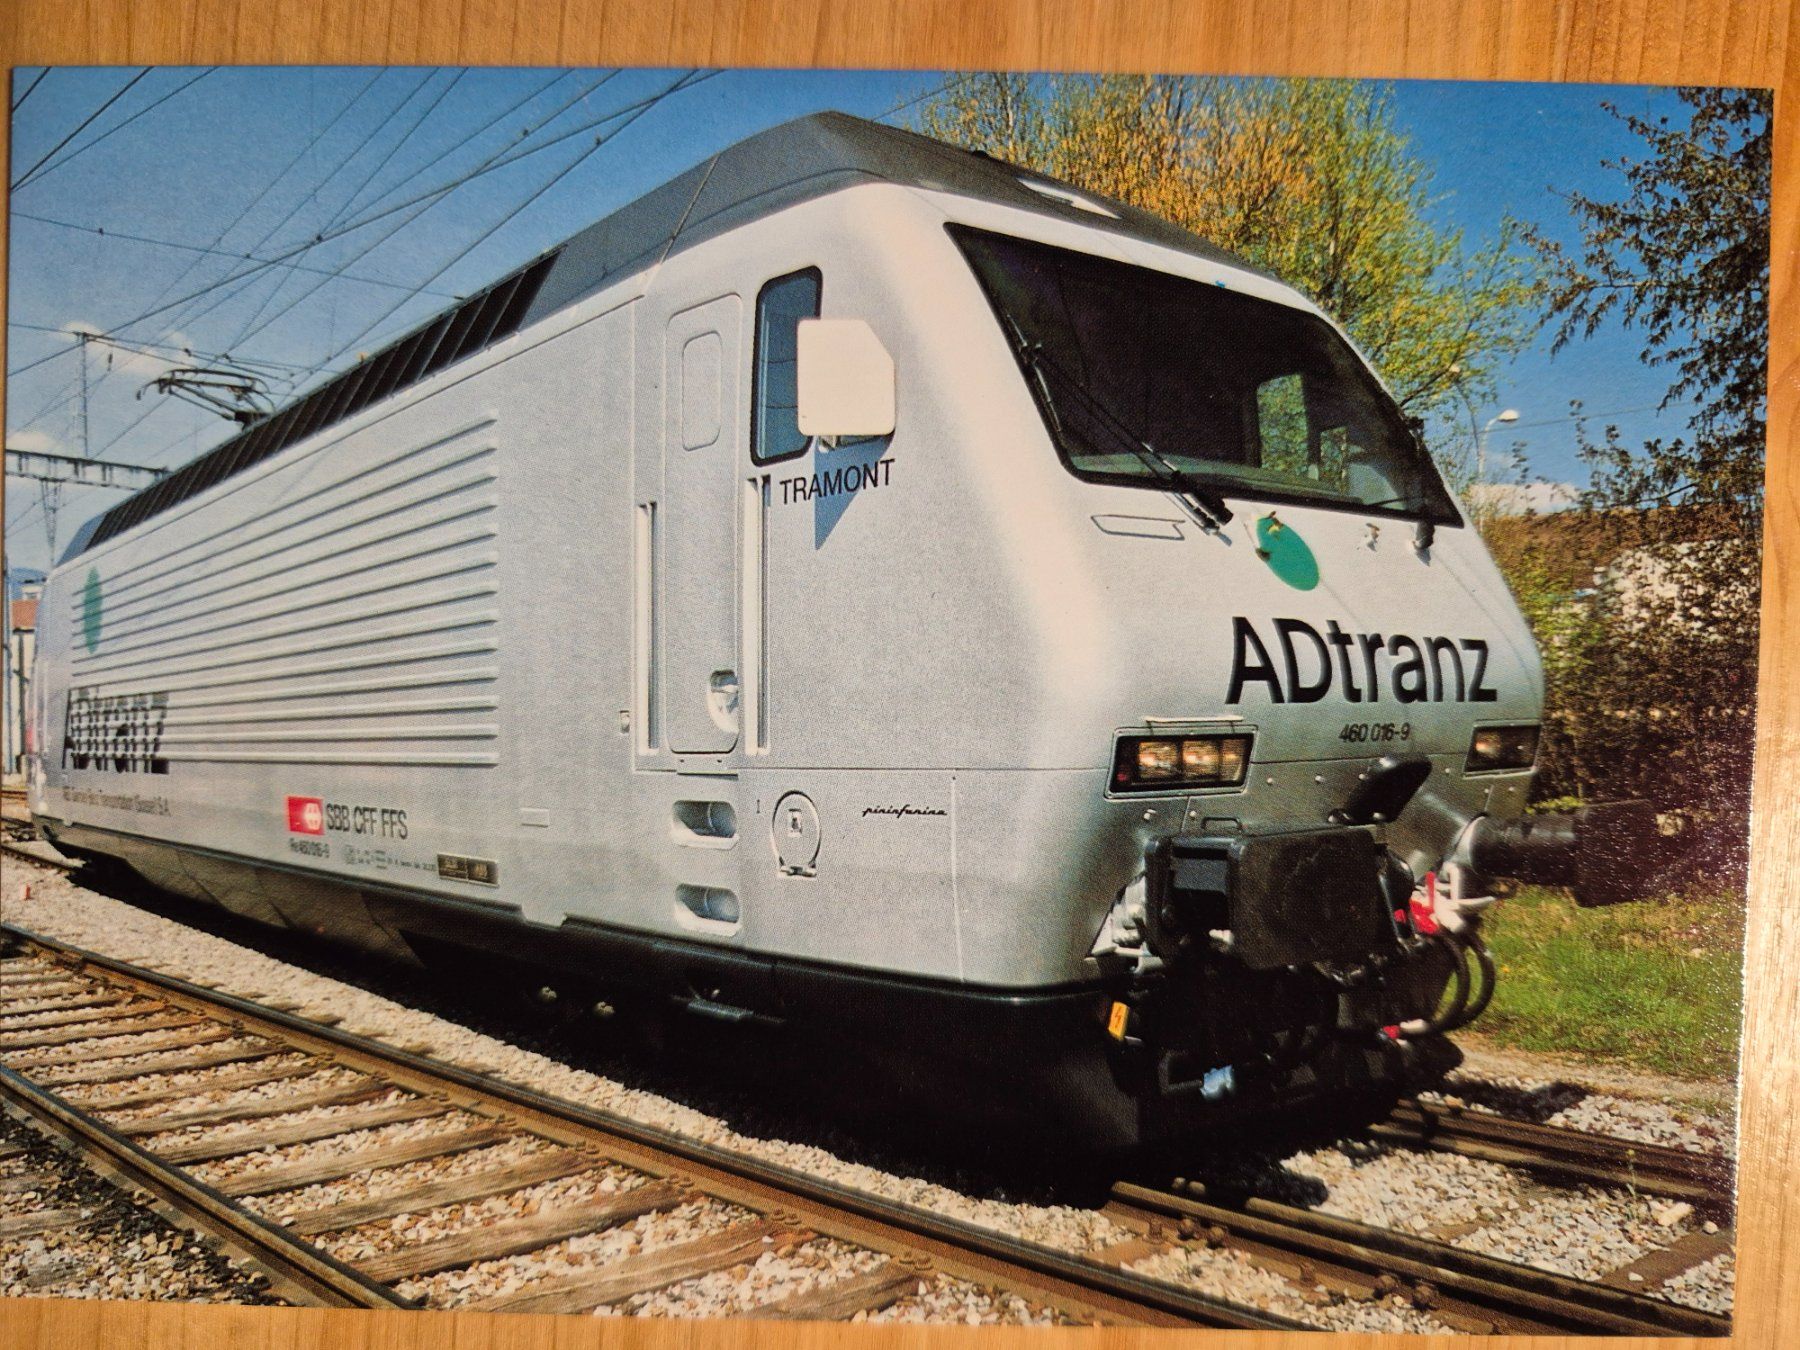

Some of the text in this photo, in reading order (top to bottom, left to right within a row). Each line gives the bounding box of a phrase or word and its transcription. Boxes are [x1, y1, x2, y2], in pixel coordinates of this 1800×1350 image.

[779, 458, 896, 505] TRAMONT
[1225, 616, 1498, 705] ADtranz
[1338, 722, 1411, 744] 460 016-9
[326, 803, 408, 840] SBB CFF FFS
[862, 804, 948, 818] pininfarina
